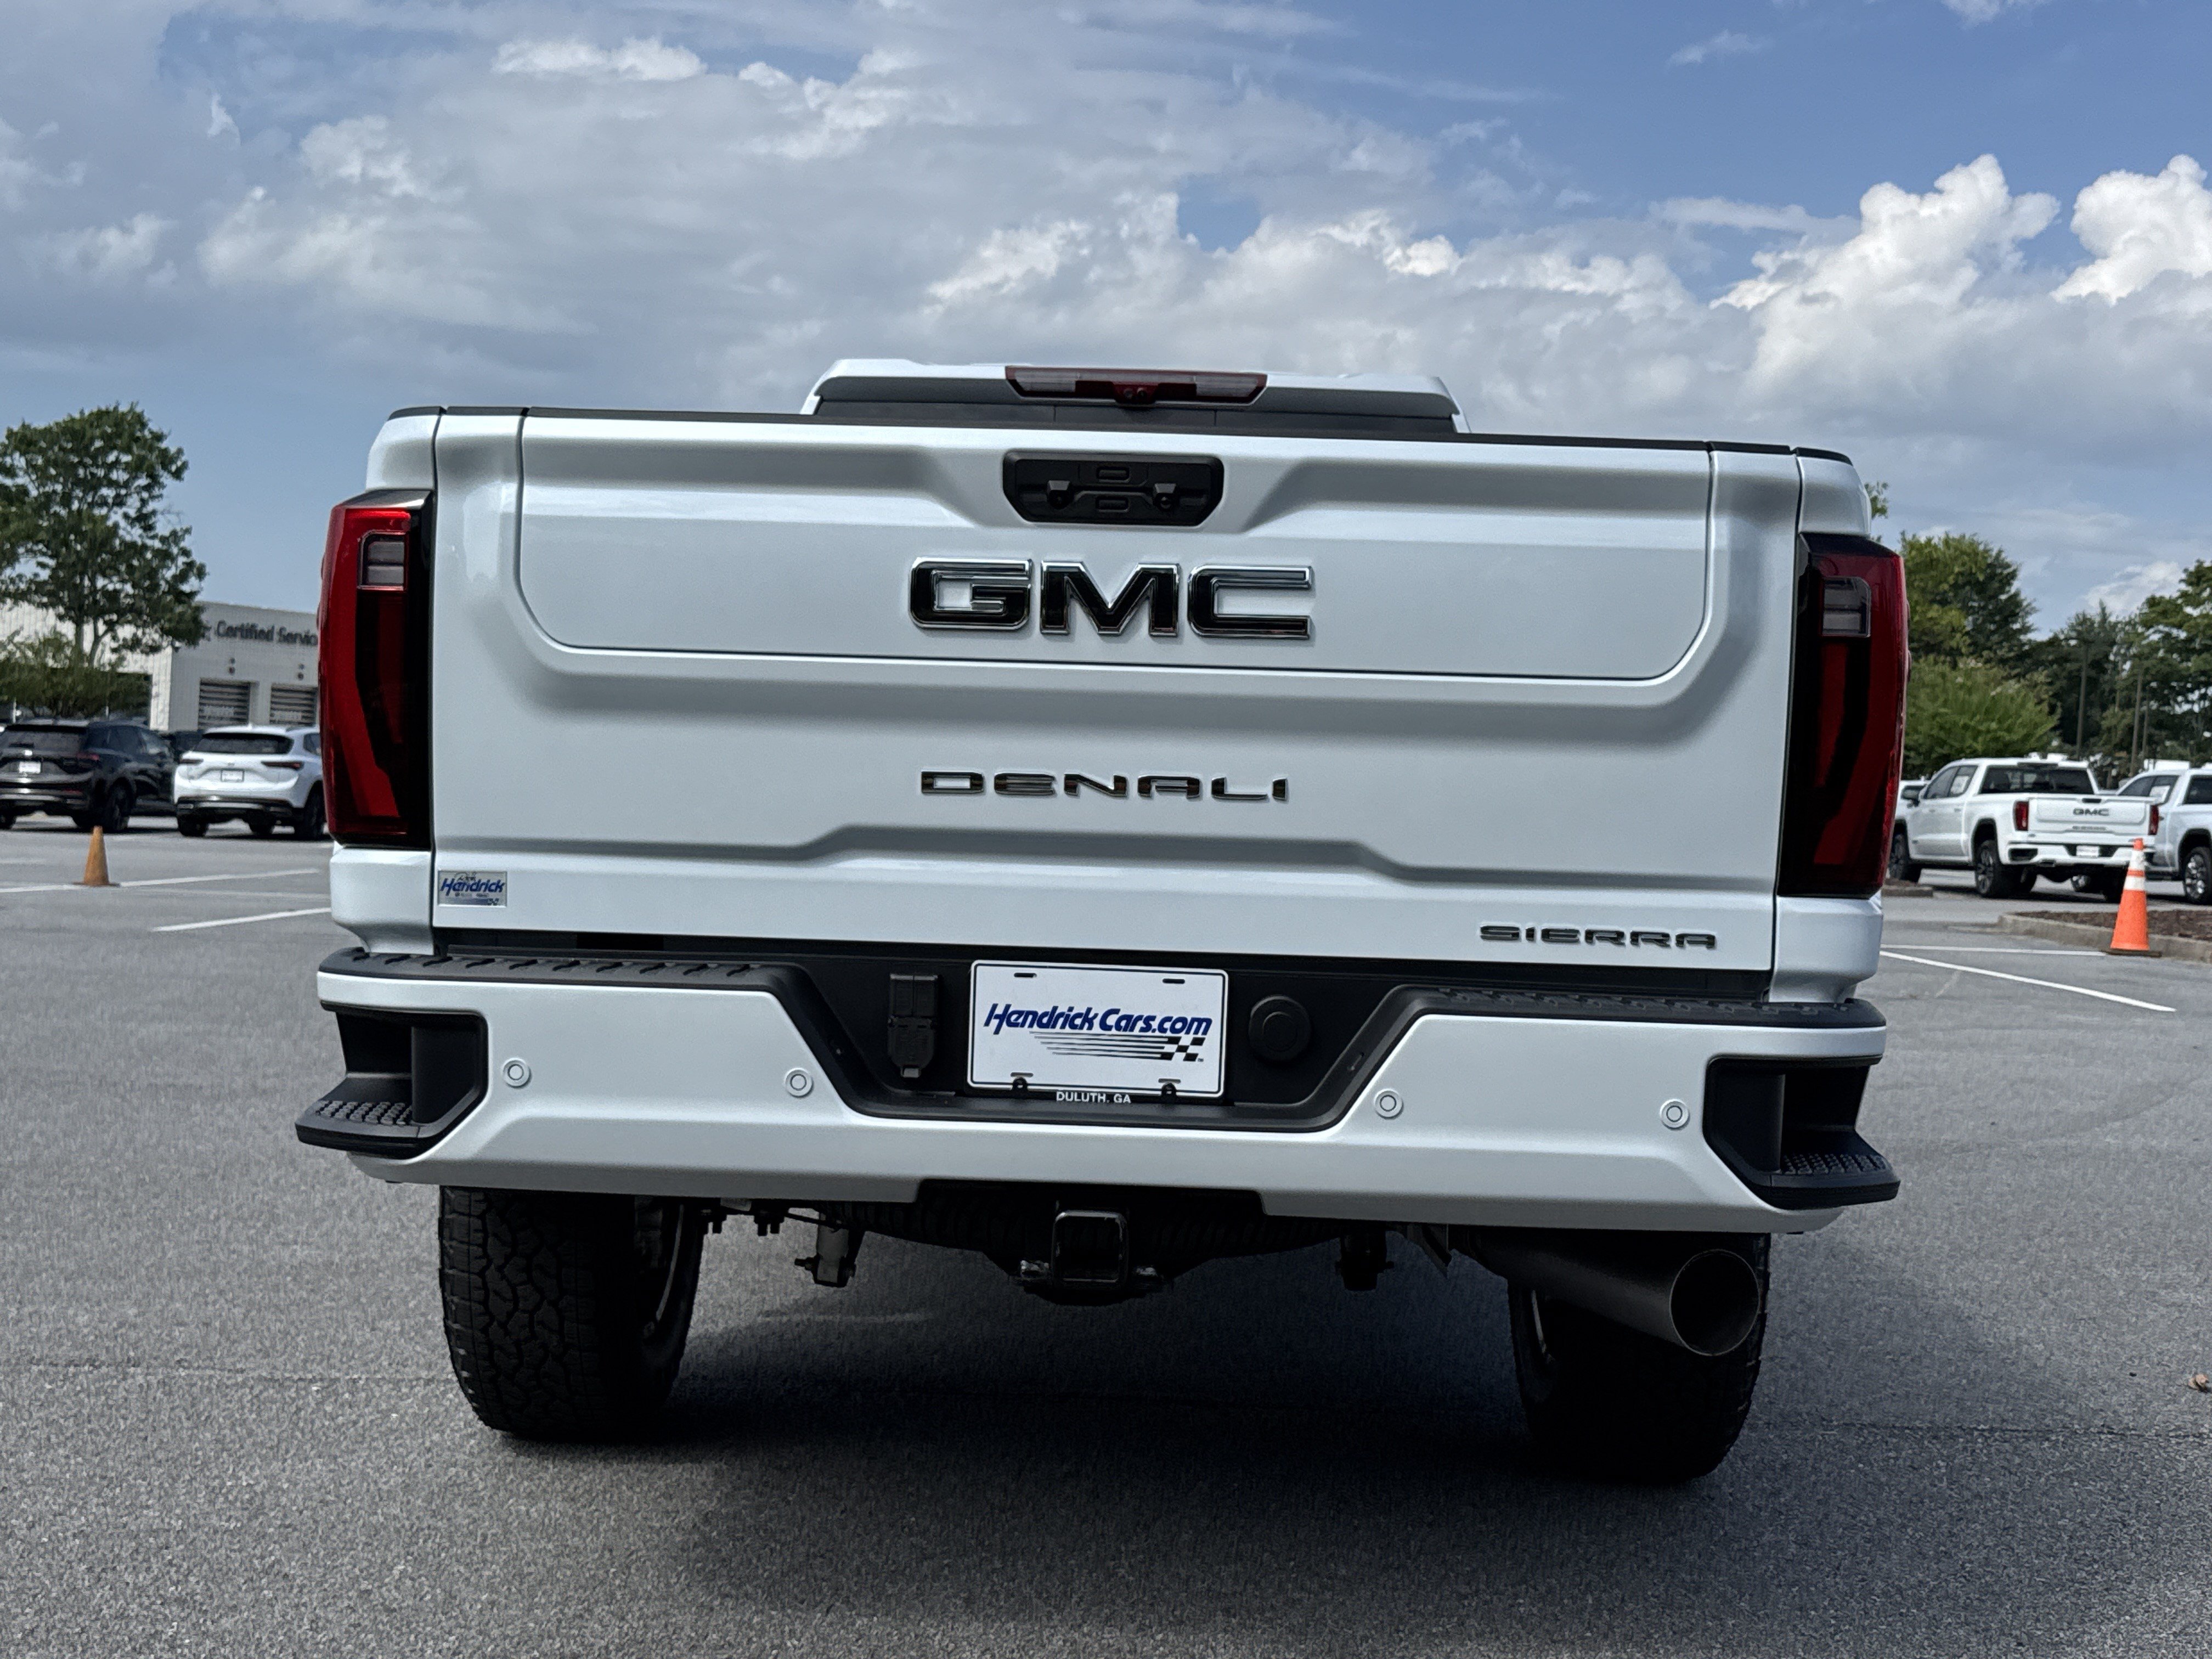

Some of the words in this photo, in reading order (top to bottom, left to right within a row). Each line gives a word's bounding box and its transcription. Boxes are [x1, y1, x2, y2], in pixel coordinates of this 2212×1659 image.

[909, 557, 1314, 640] GMC
[217, 619, 274, 642] Certified
[921, 770, 1288, 801] DENALI
[2073, 808, 2109, 816] GMC
[440, 878, 505, 896] Hendrick
[1480, 926, 1717, 950] SIERRA
[1114, 1093, 1131, 1103] GA
